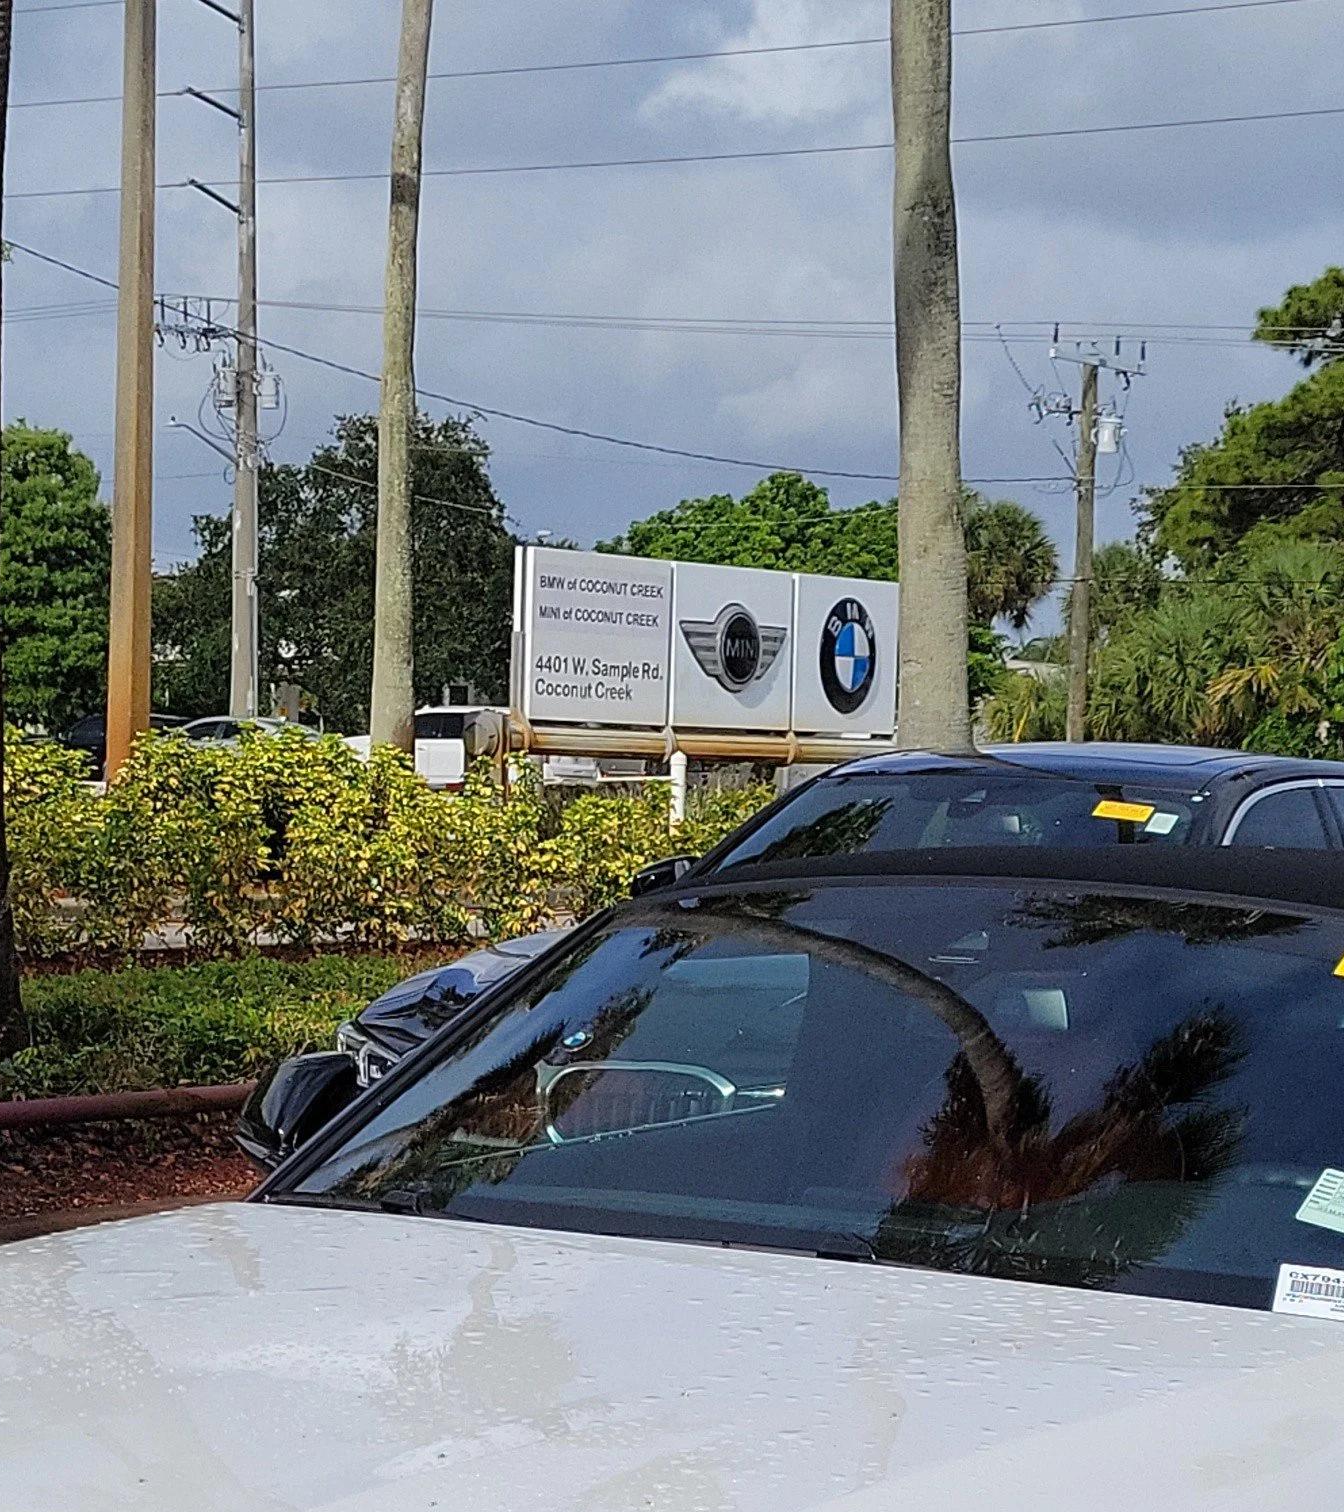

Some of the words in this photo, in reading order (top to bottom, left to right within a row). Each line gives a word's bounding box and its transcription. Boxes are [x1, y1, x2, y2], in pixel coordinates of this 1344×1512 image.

[540, 575, 565, 590] BMW
[567, 578, 577, 590] of
[579, 579, 628, 596] COCONUT
[630, 584, 664, 599] CREEK
[539, 605, 561, 619] MINI
[563, 608, 573, 620] of
[575, 608, 623, 625] COCONUT
[625, 613, 659, 628] CREEK
[535, 656, 568, 674] 4401
[572, 657, 589, 676] W.
[592, 658, 639, 682] Sample
[642, 663, 664, 681] Rd.
[535, 678, 592, 699] Coconut
[595, 681, 632, 701] Creek
